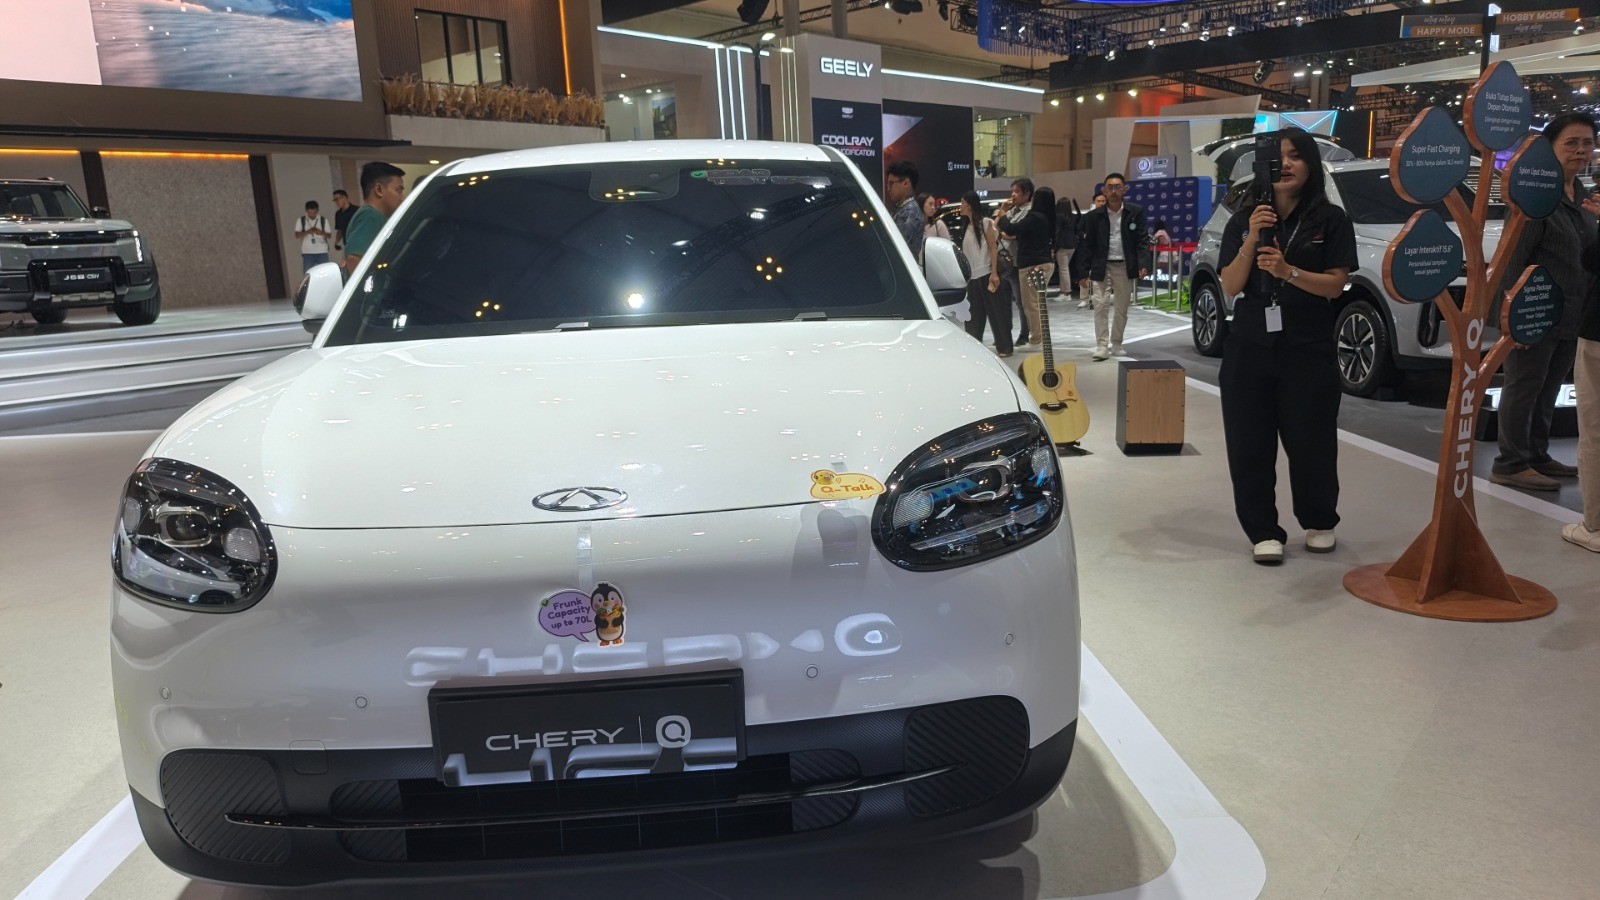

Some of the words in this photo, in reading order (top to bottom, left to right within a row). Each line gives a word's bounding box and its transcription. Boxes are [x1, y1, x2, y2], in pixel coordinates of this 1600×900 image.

[1503, 12, 1535, 22] HOBBY
[1537, 11, 1566, 20] MODE
[1417, 27, 1446, 36] HAPPY
[1448, 26, 1475, 35] MODE
[820, 56, 873, 78] GEELY
[821, 134, 874, 147] COOLRAY
[1411, 145, 1426, 155] Super
[1427, 145, 1438, 153] Fast
[1438, 144, 1460, 155] Charging
[1404, 247, 1418, 256] Layar
[1419, 245, 1442, 254] Interaktif
[1454, 362, 1478, 498] CHERY
[1467, 318, 1483, 350] Q
[821, 484, 874, 493] Q-Talk
[552, 597, 582, 610] Frunk
[547, 605, 591, 620] Capacity
[551, 622, 562, 630] up
[575, 615, 592, 625] 70L
[486, 727, 624, 751] CHERY
